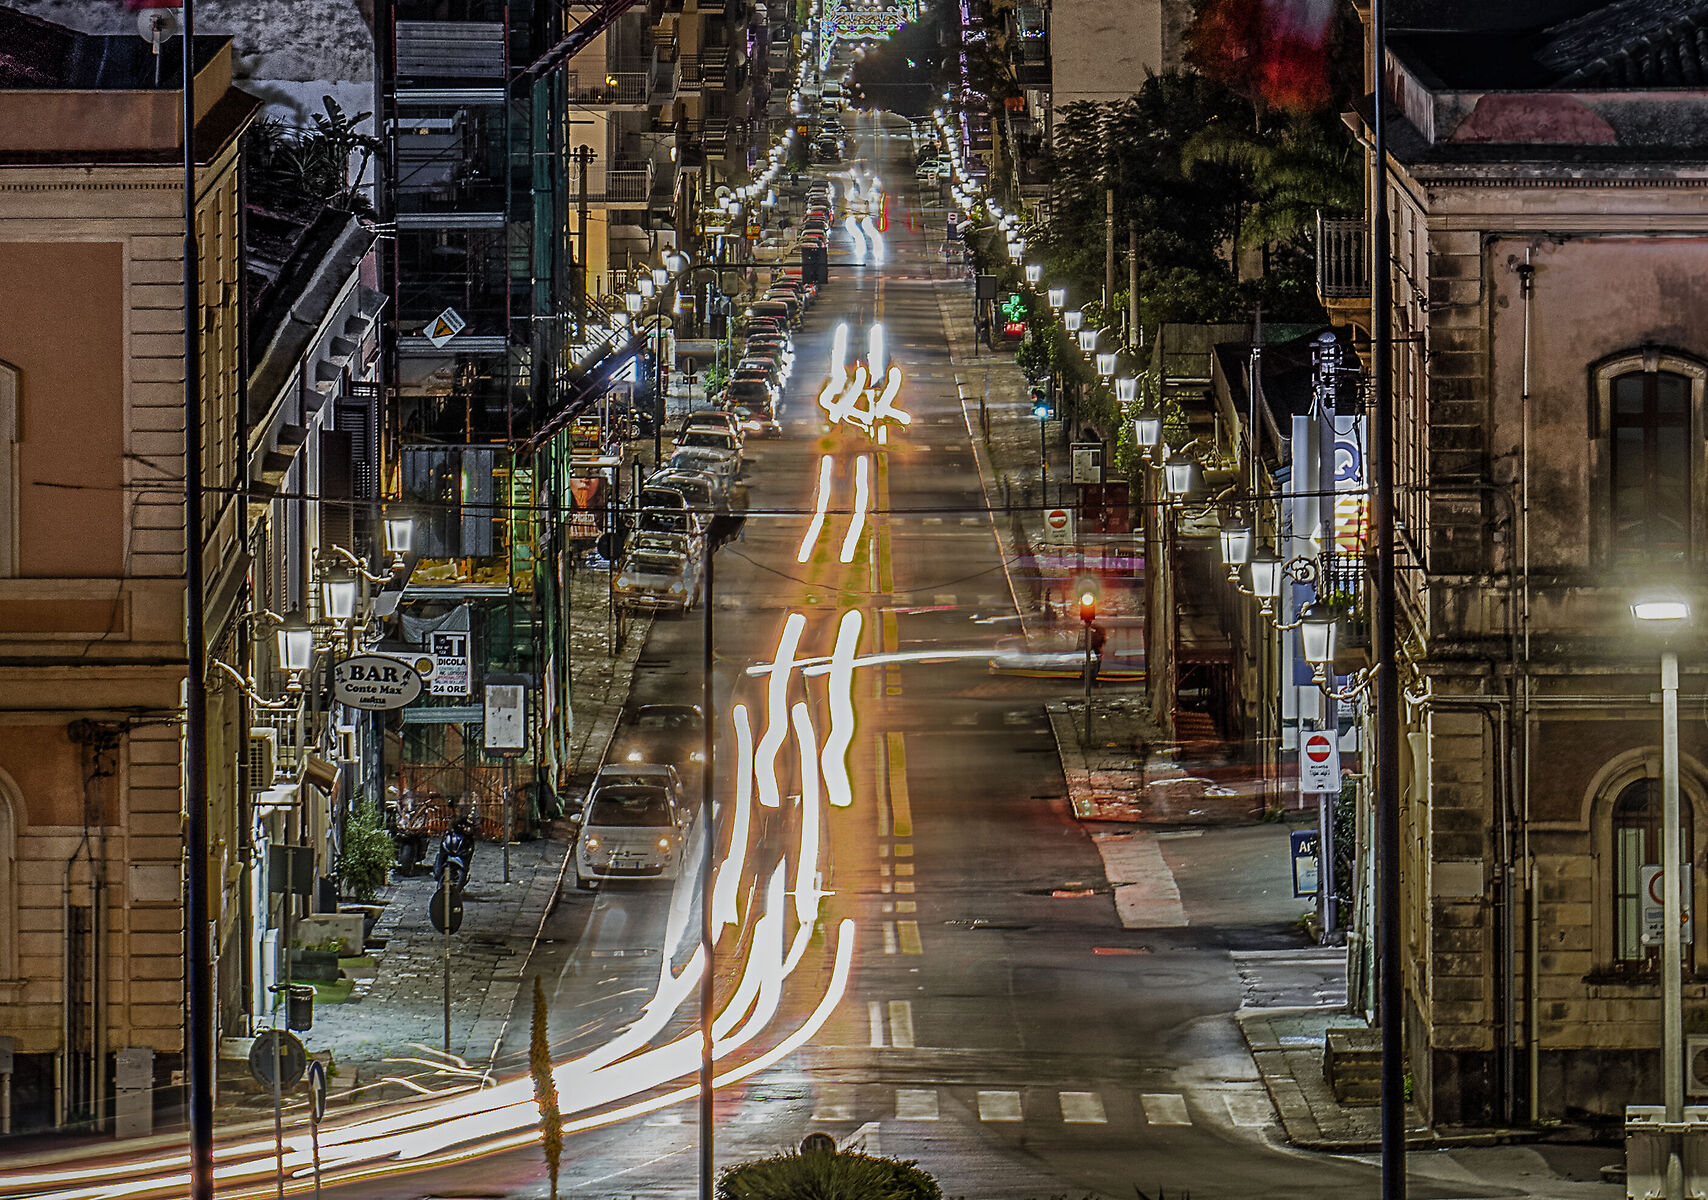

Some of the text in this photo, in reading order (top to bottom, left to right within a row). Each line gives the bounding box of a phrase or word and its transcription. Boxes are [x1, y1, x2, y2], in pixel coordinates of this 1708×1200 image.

[446, 636, 465, 656] T
[437, 658, 466, 666] DICOLA
[349, 665, 399, 682] BAR
[345, 683, 403, 695] Conte Max
[433, 685, 467, 693] 24 ORE
